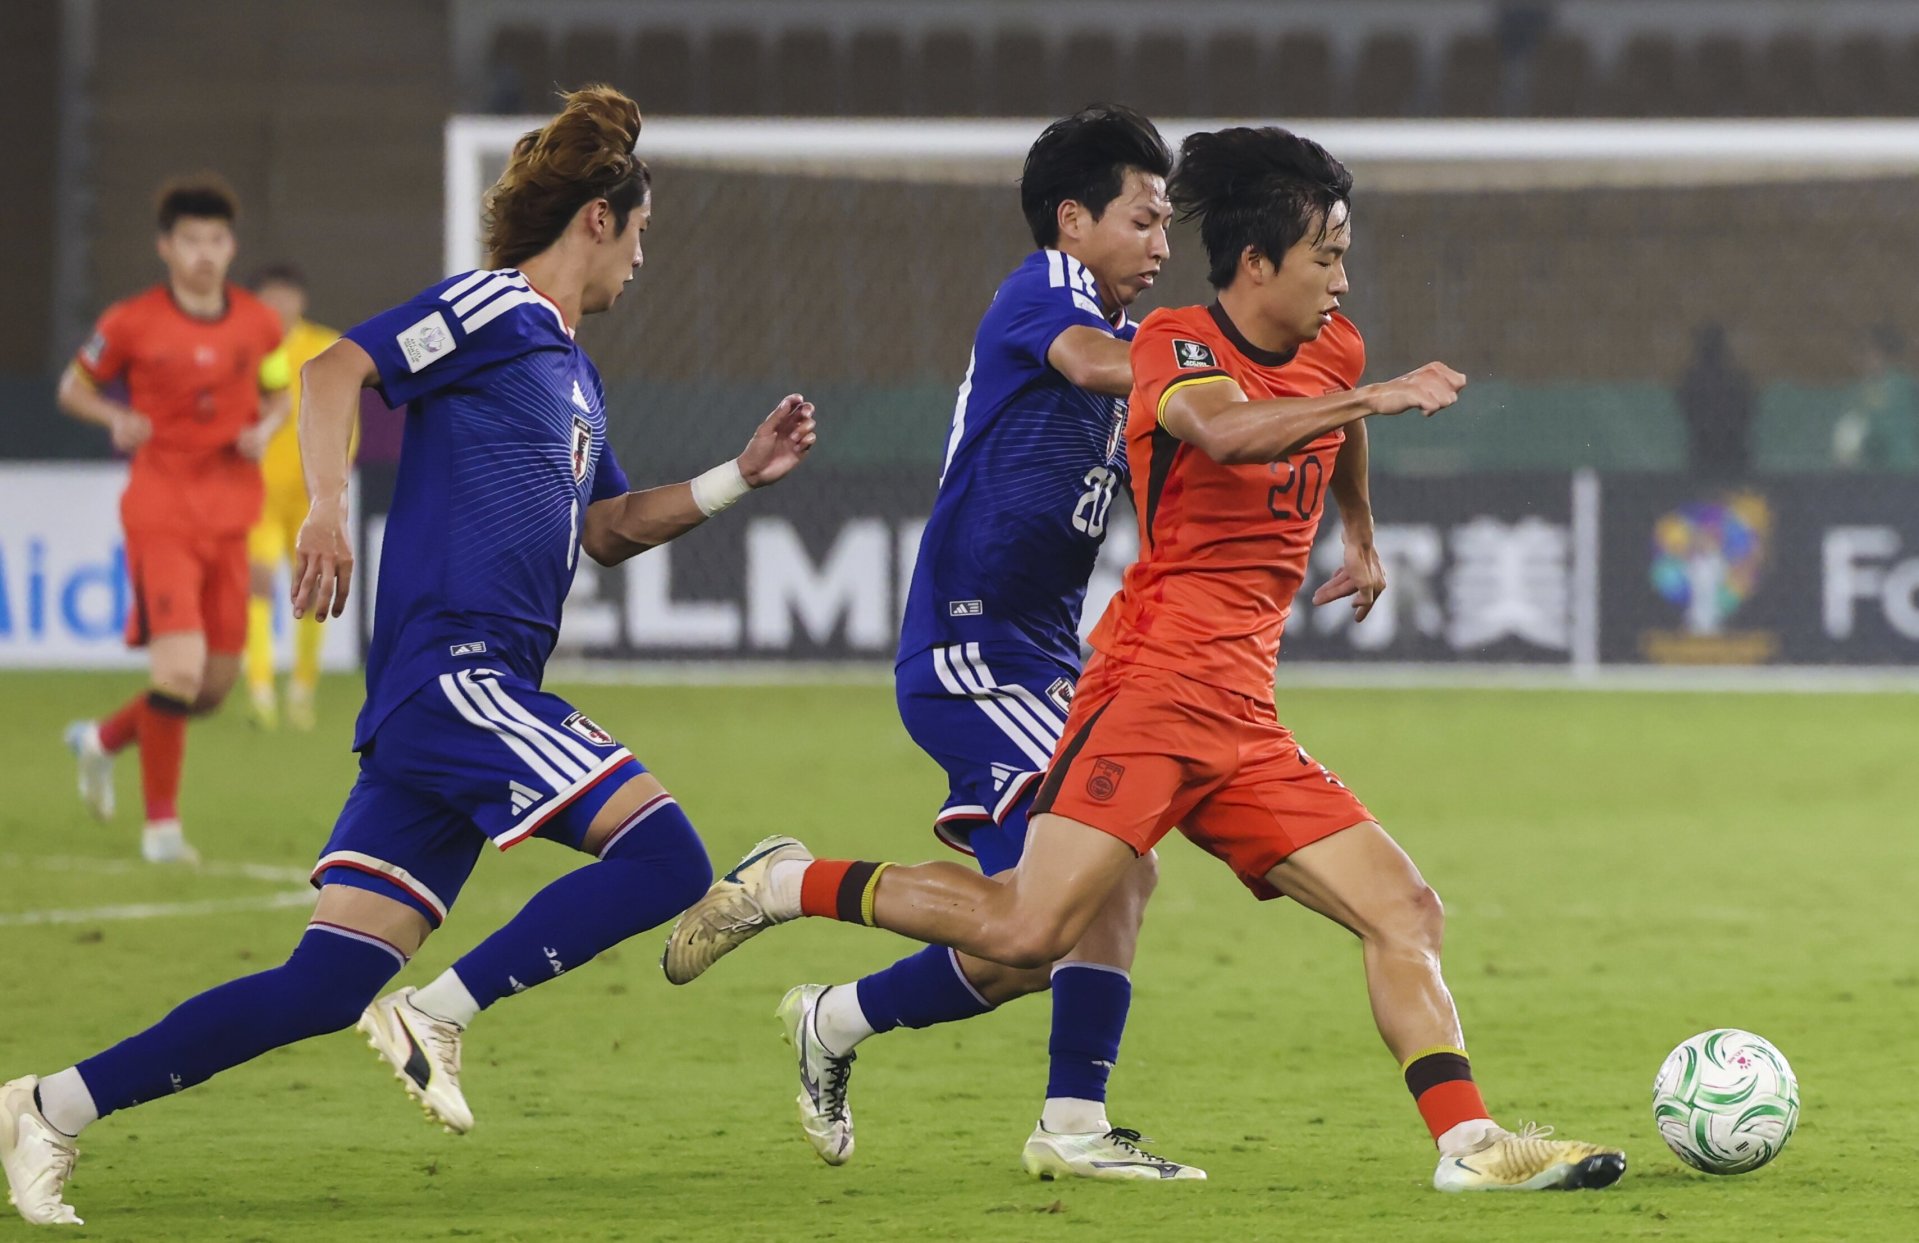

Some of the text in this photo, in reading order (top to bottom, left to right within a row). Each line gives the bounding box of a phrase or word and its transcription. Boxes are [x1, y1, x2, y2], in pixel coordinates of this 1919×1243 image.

[1072, 466, 1117, 538] 20
[1267, 455, 1322, 520] 20
[0, 535, 127, 644] id
[1284, 515, 1569, 650] 尔美
